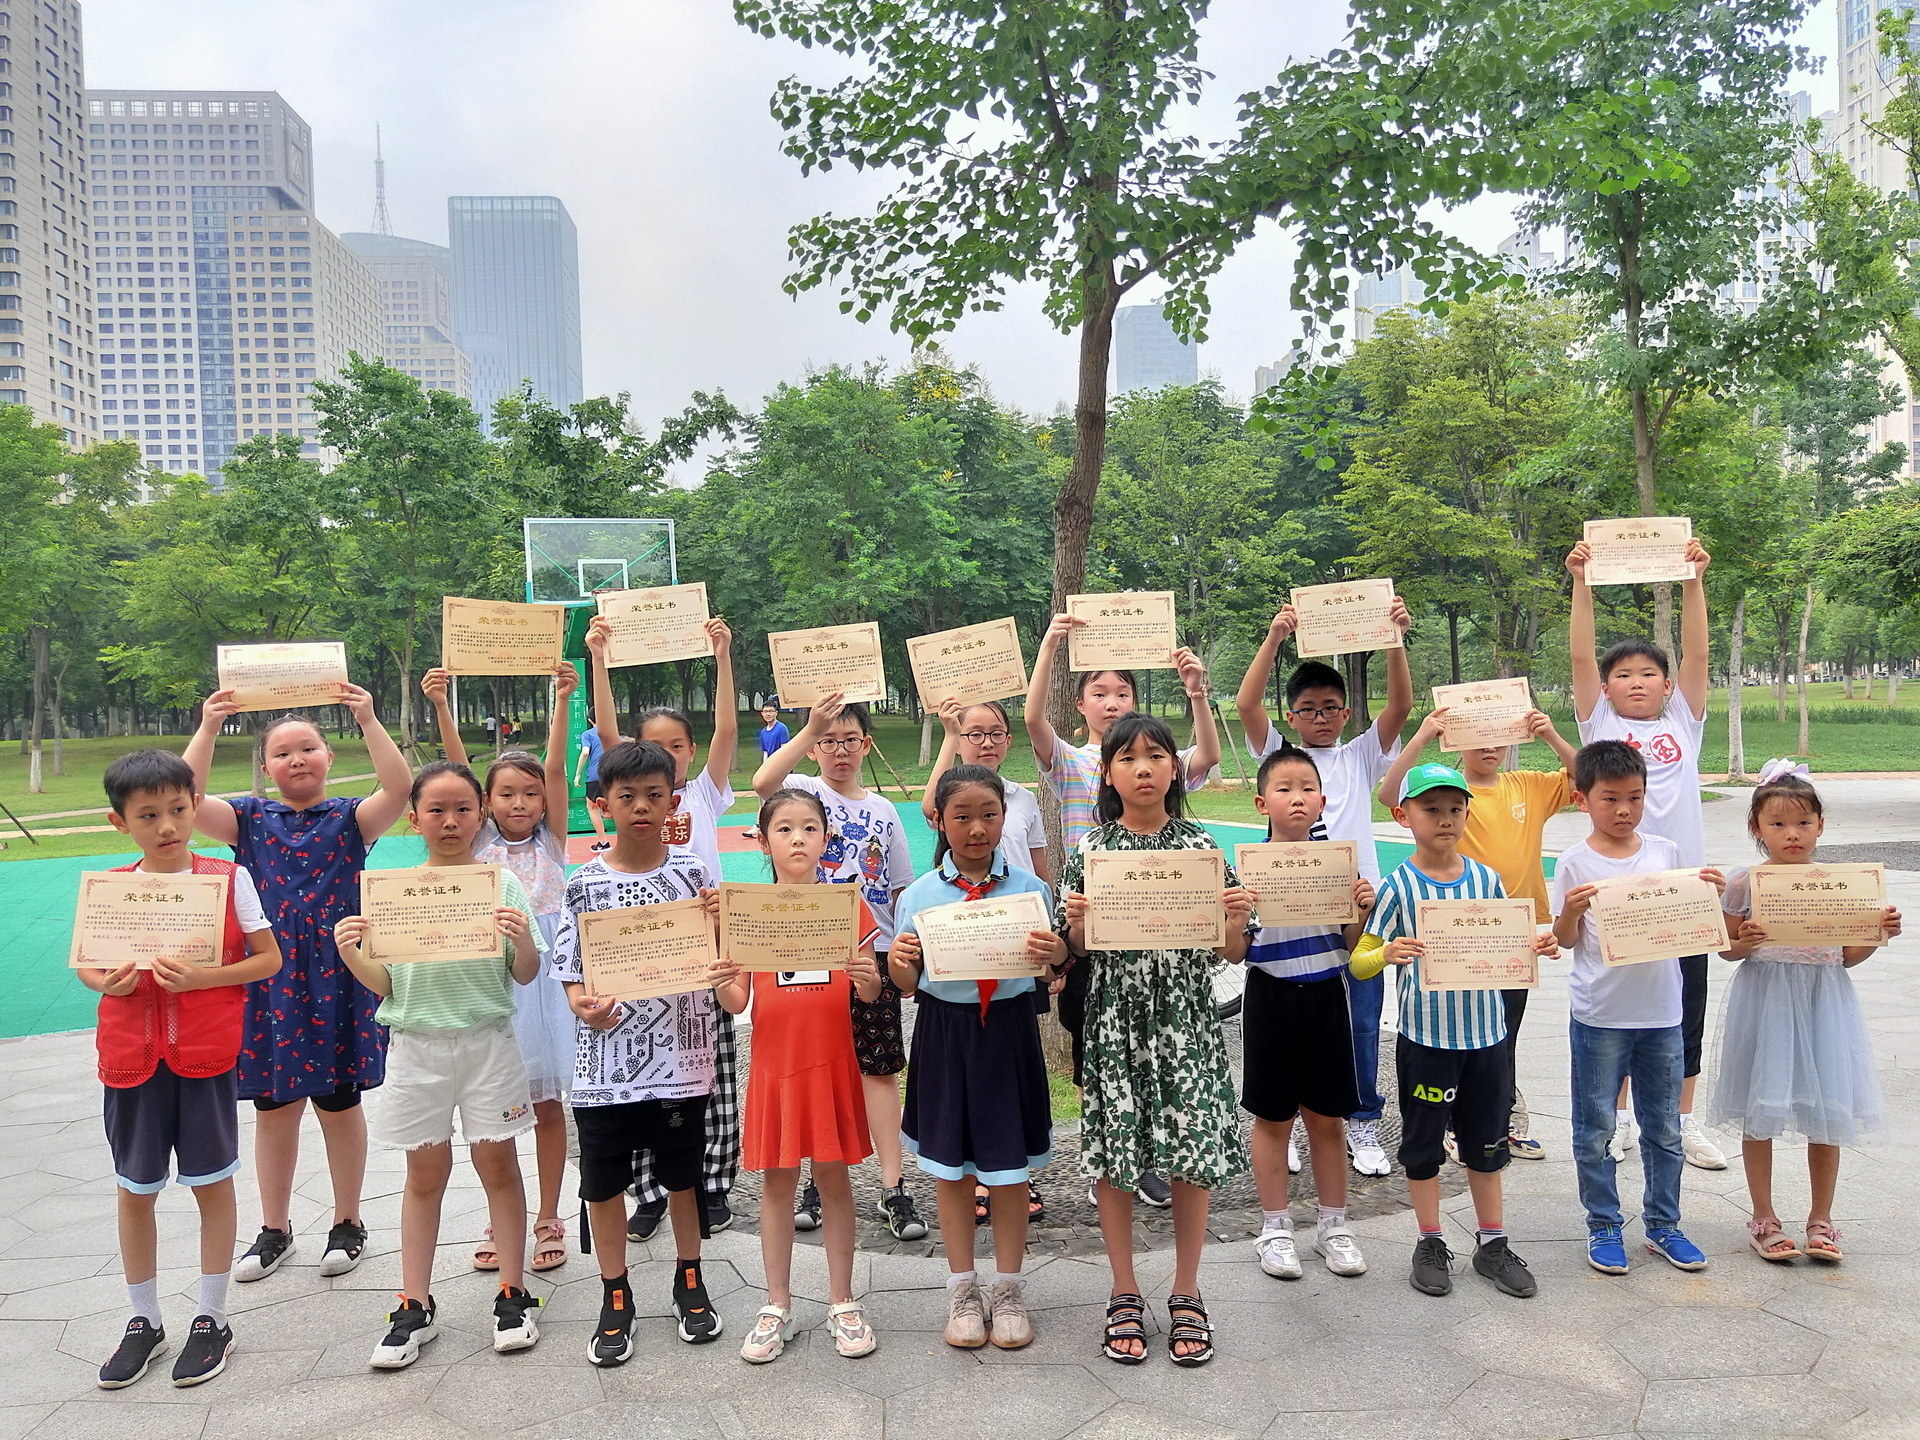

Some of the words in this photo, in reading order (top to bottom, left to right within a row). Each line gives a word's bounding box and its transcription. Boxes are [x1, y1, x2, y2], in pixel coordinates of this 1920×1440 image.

[1615, 531, 1661, 540] 荣誉证书
[1322, 594, 1366, 606] 荣誉证书
[631, 601, 677, 613] 荣誉证书
[1099, 608, 1144, 617] 荣誉证书
[477, 616, 529, 626] 荣誉证书
[802, 641, 849, 654] 荣誉证书
[940, 639, 986, 656] 荣誉证书
[859, 809, 871, 828] 4
[872, 820, 884, 834] 5
[1270, 858, 1322, 869] 荣誉证书
[1123, 870, 1183, 881] 荣誉证书
[402, 884, 462, 897] 荣誉证书
[1790, 881, 1848, 891] 荣誉证书
[122, 892, 185, 903] 荣誉证书
[1626, 886, 1679, 902] 荣誉证书
[760, 902, 820, 912] 荣誉证书
[953, 909, 1008, 921] 荣誉证书
[619, 919, 675, 936] 荣誉证书
[1452, 917, 1502, 927] 荣誉证书
